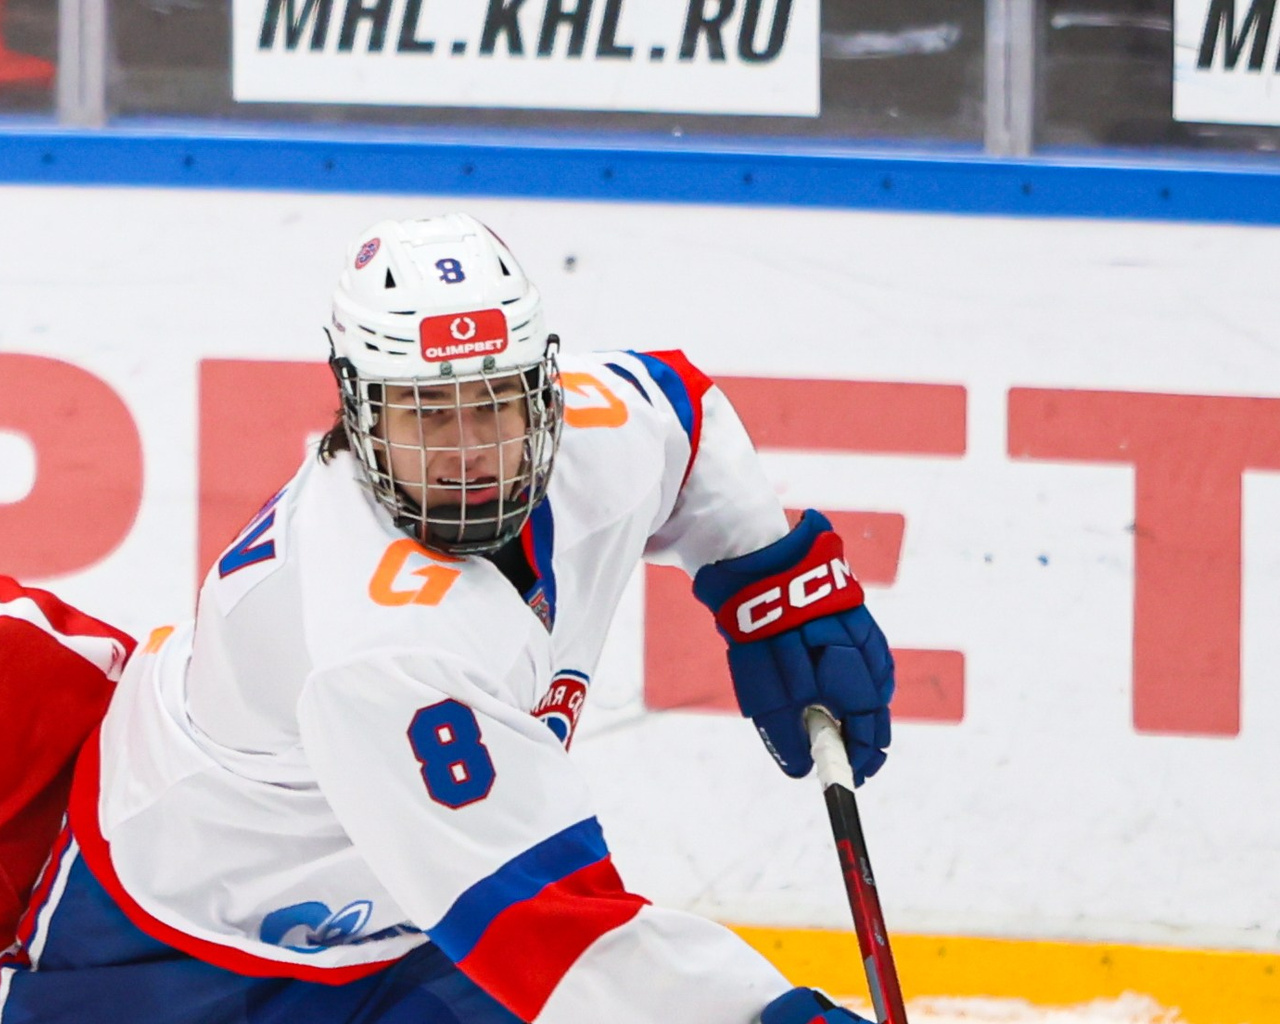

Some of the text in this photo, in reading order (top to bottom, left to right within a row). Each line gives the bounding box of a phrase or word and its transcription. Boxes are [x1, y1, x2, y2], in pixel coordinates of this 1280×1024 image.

[258, 0, 795, 63] MHL.KHL.RU
[1196, 0, 1280, 72] M
[434, 258, 465, 284] 8
[425, 339, 504, 358] OLIMPBET
[368, 538, 462, 607] G
[736, 557, 857, 634] CCM
[407, 697, 497, 810] 8
